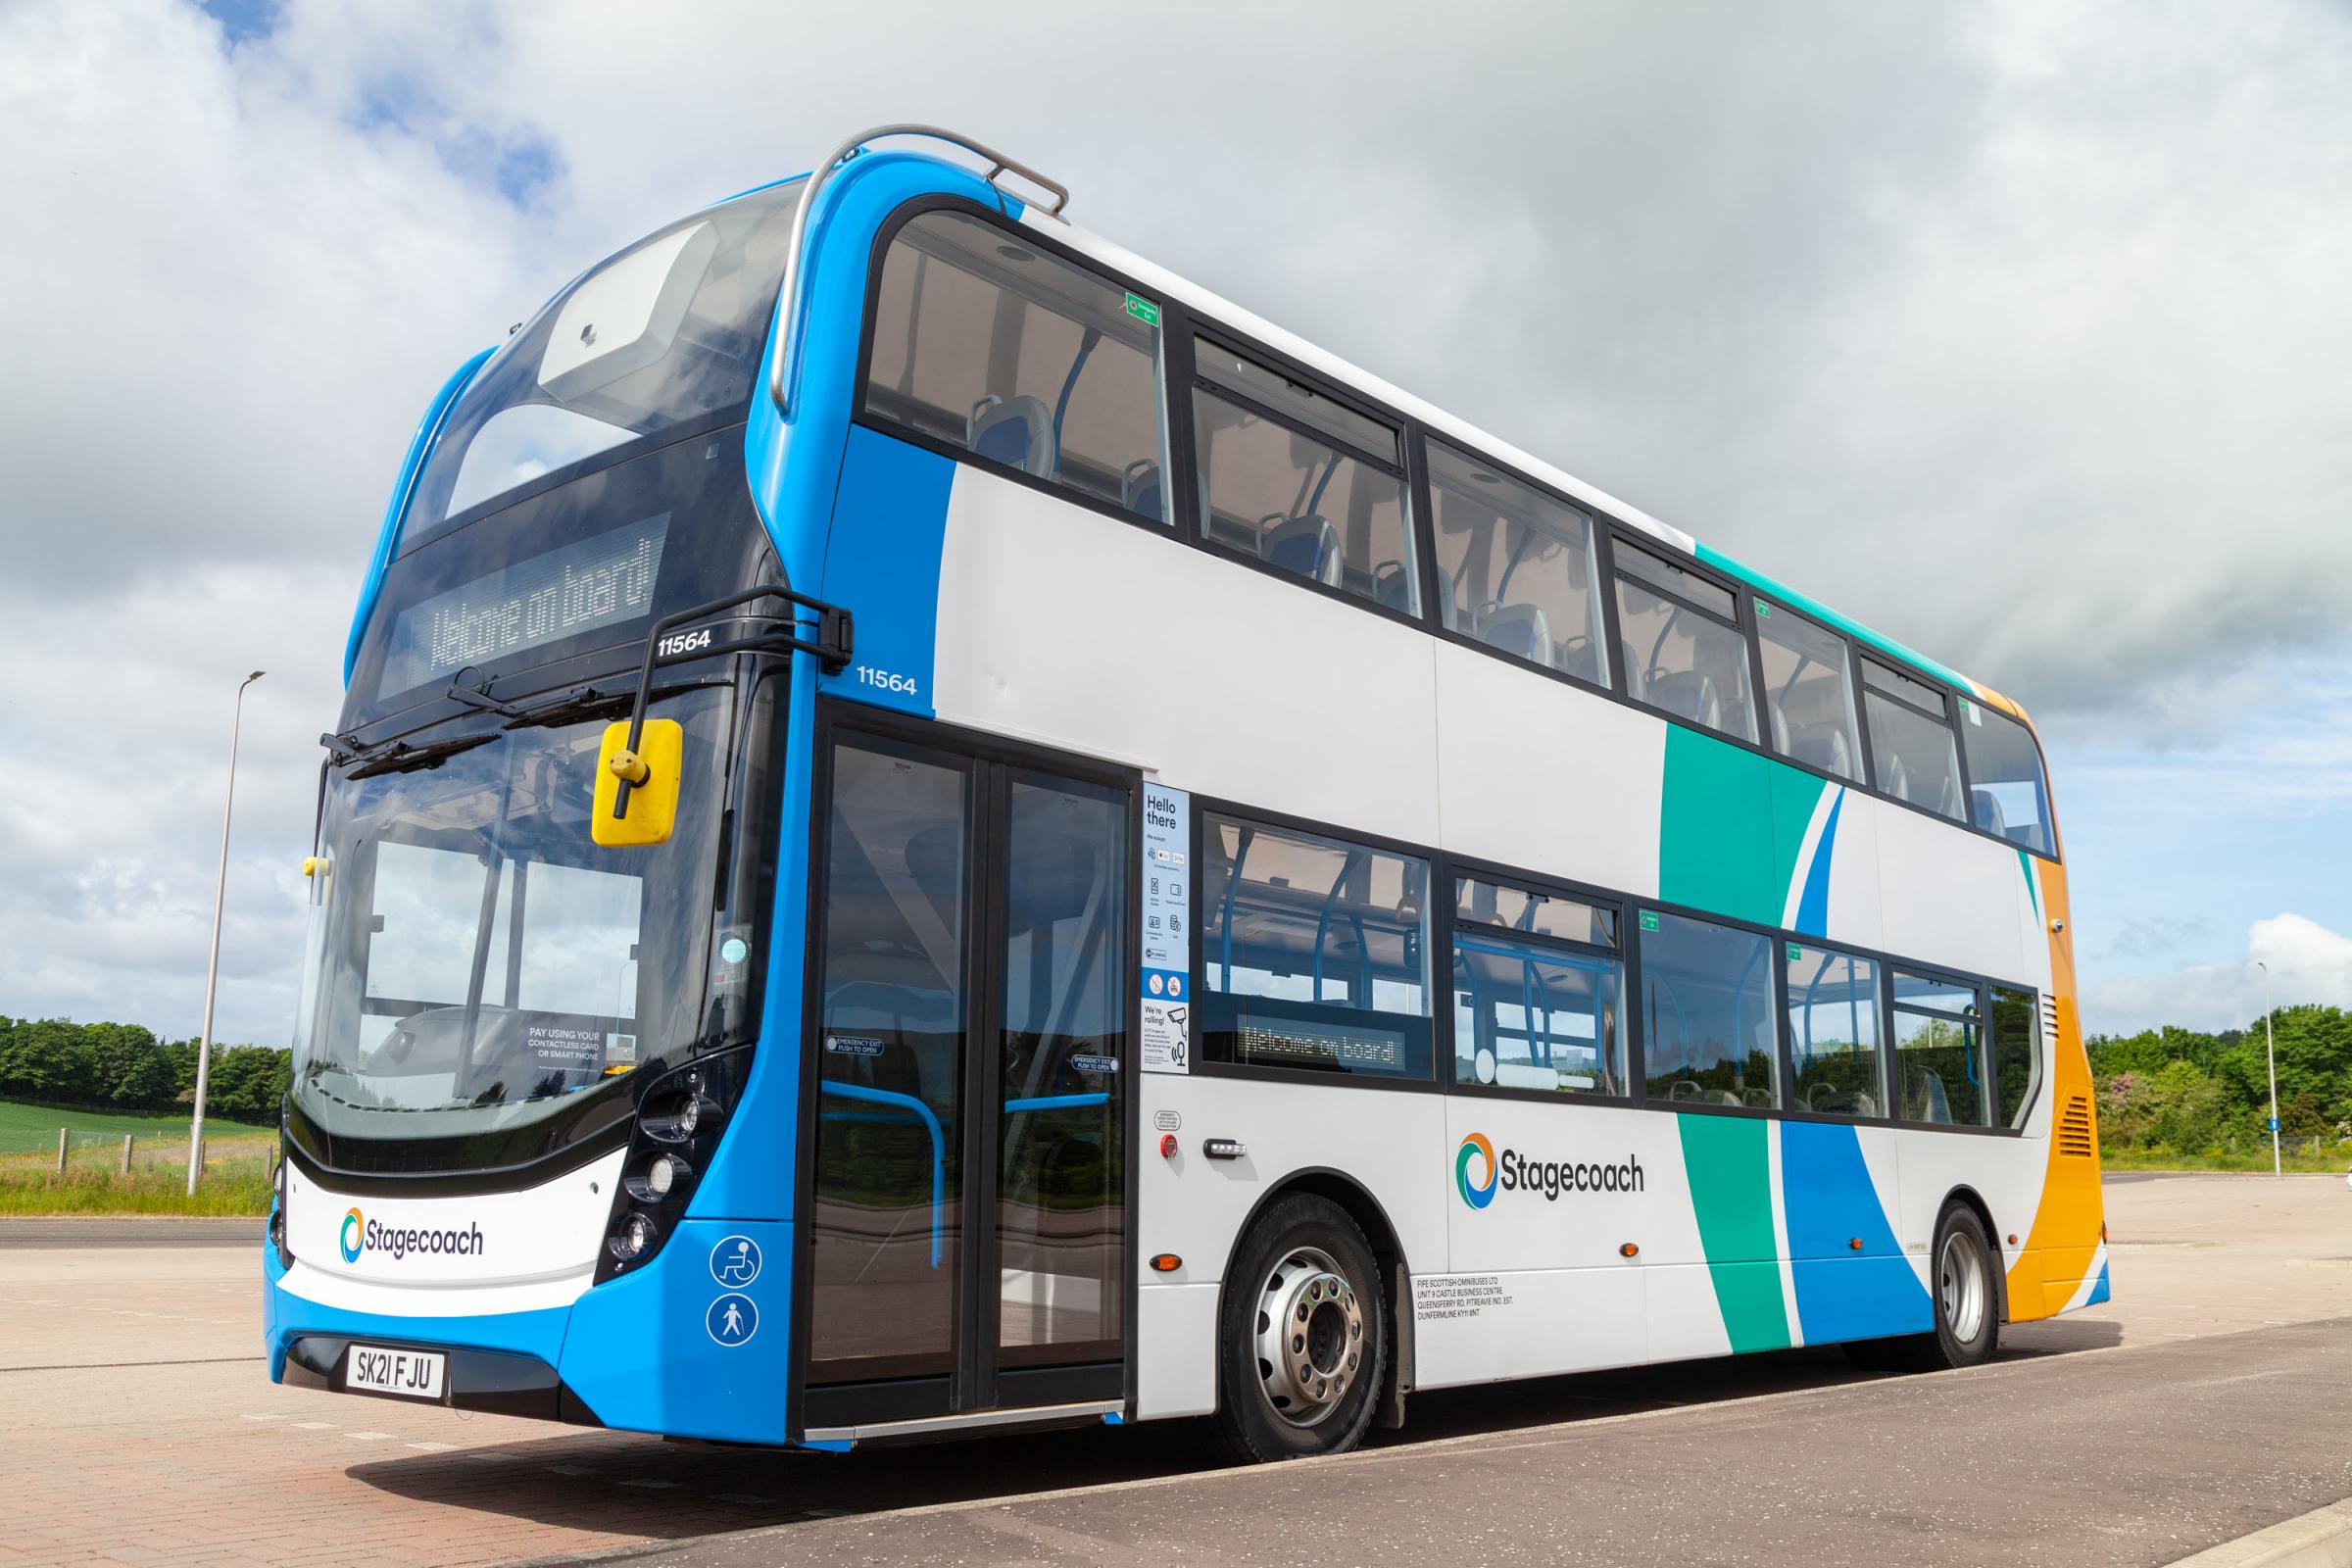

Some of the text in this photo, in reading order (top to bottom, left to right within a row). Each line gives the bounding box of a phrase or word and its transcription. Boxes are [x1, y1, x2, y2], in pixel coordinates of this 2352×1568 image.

[658, 629, 711, 657] 11564
[856, 665, 917, 696] 11564
[1148, 795, 1176, 814] Hello
[1147, 811, 1176, 829] there
[1145, 1005, 1162, 1015] We're
[1145, 1016, 1165, 1027] rolling!
[529, 1027, 600, 1042] PAY USING YOUR
[1246, 1026, 1314, 1054] Welcome
[1320, 1040, 1339, 1057] on
[528, 1039, 600, 1052] CONTACTLESS CARD
[837, 1038, 868, 1047] EMERGENCY
[550, 1050, 574, 1059] SMART
[575, 1052, 599, 1060] PHONE
[1500, 1149, 1644, 1201] Stagecoach
[366, 1218, 484, 1260] Stagecoach
[1417, 1279, 1429, 1288] FIFE
[1430, 1278, 1456, 1288] SCOTTISH
[1457, 1277, 1489, 1287] OMNIBUSES
[1417, 1290, 1430, 1298] UNIT
[1436, 1289, 1456, 1298] CASTLE
[1457, 1288, 1483, 1297] BUSINESS
[1483, 1287, 1502, 1296] CENTRE
[1417, 1299, 1456, 1309] QUEENSFERRY
[1466, 1298, 1492, 1306] PITREAVIE
[1417, 1309, 1456, 1320] DUNFERMLINE
[357, 1351, 431, 1390] SK21 FJU
